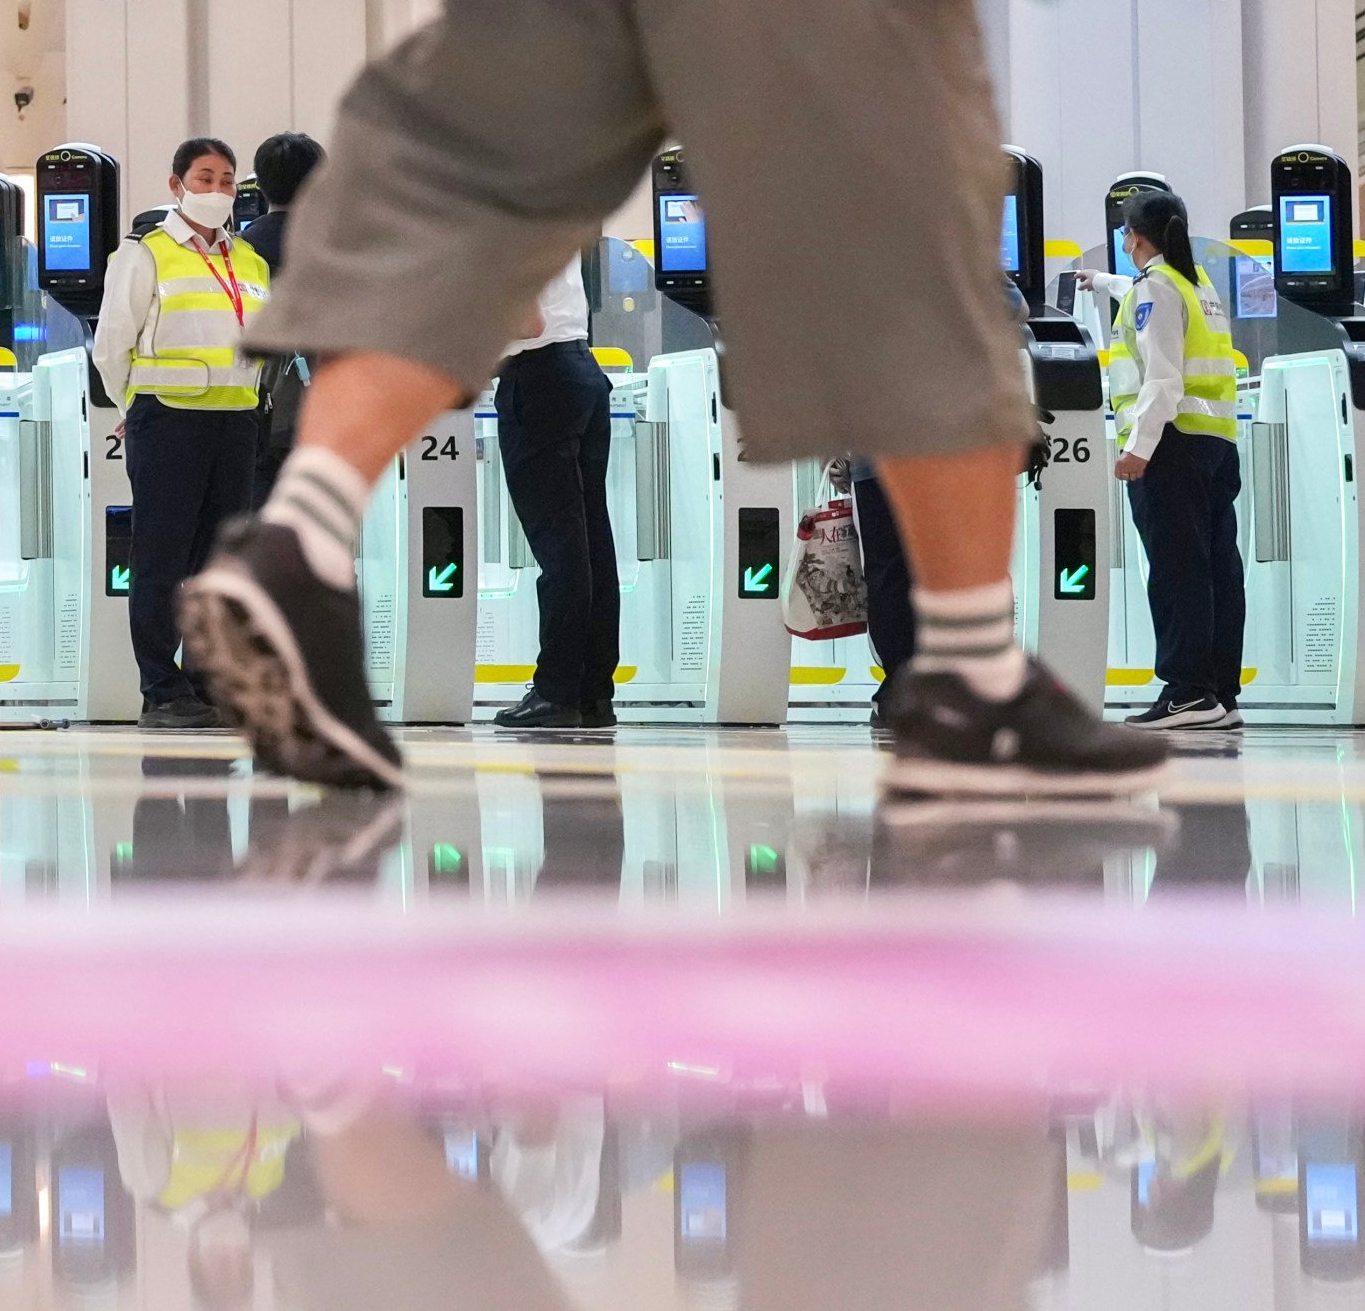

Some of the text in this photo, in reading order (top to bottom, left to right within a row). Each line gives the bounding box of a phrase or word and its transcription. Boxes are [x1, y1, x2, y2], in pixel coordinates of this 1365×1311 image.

[105, 434, 124, 460] 2
[421, 435, 460, 461] 24
[1052, 437, 1091, 463] 26
